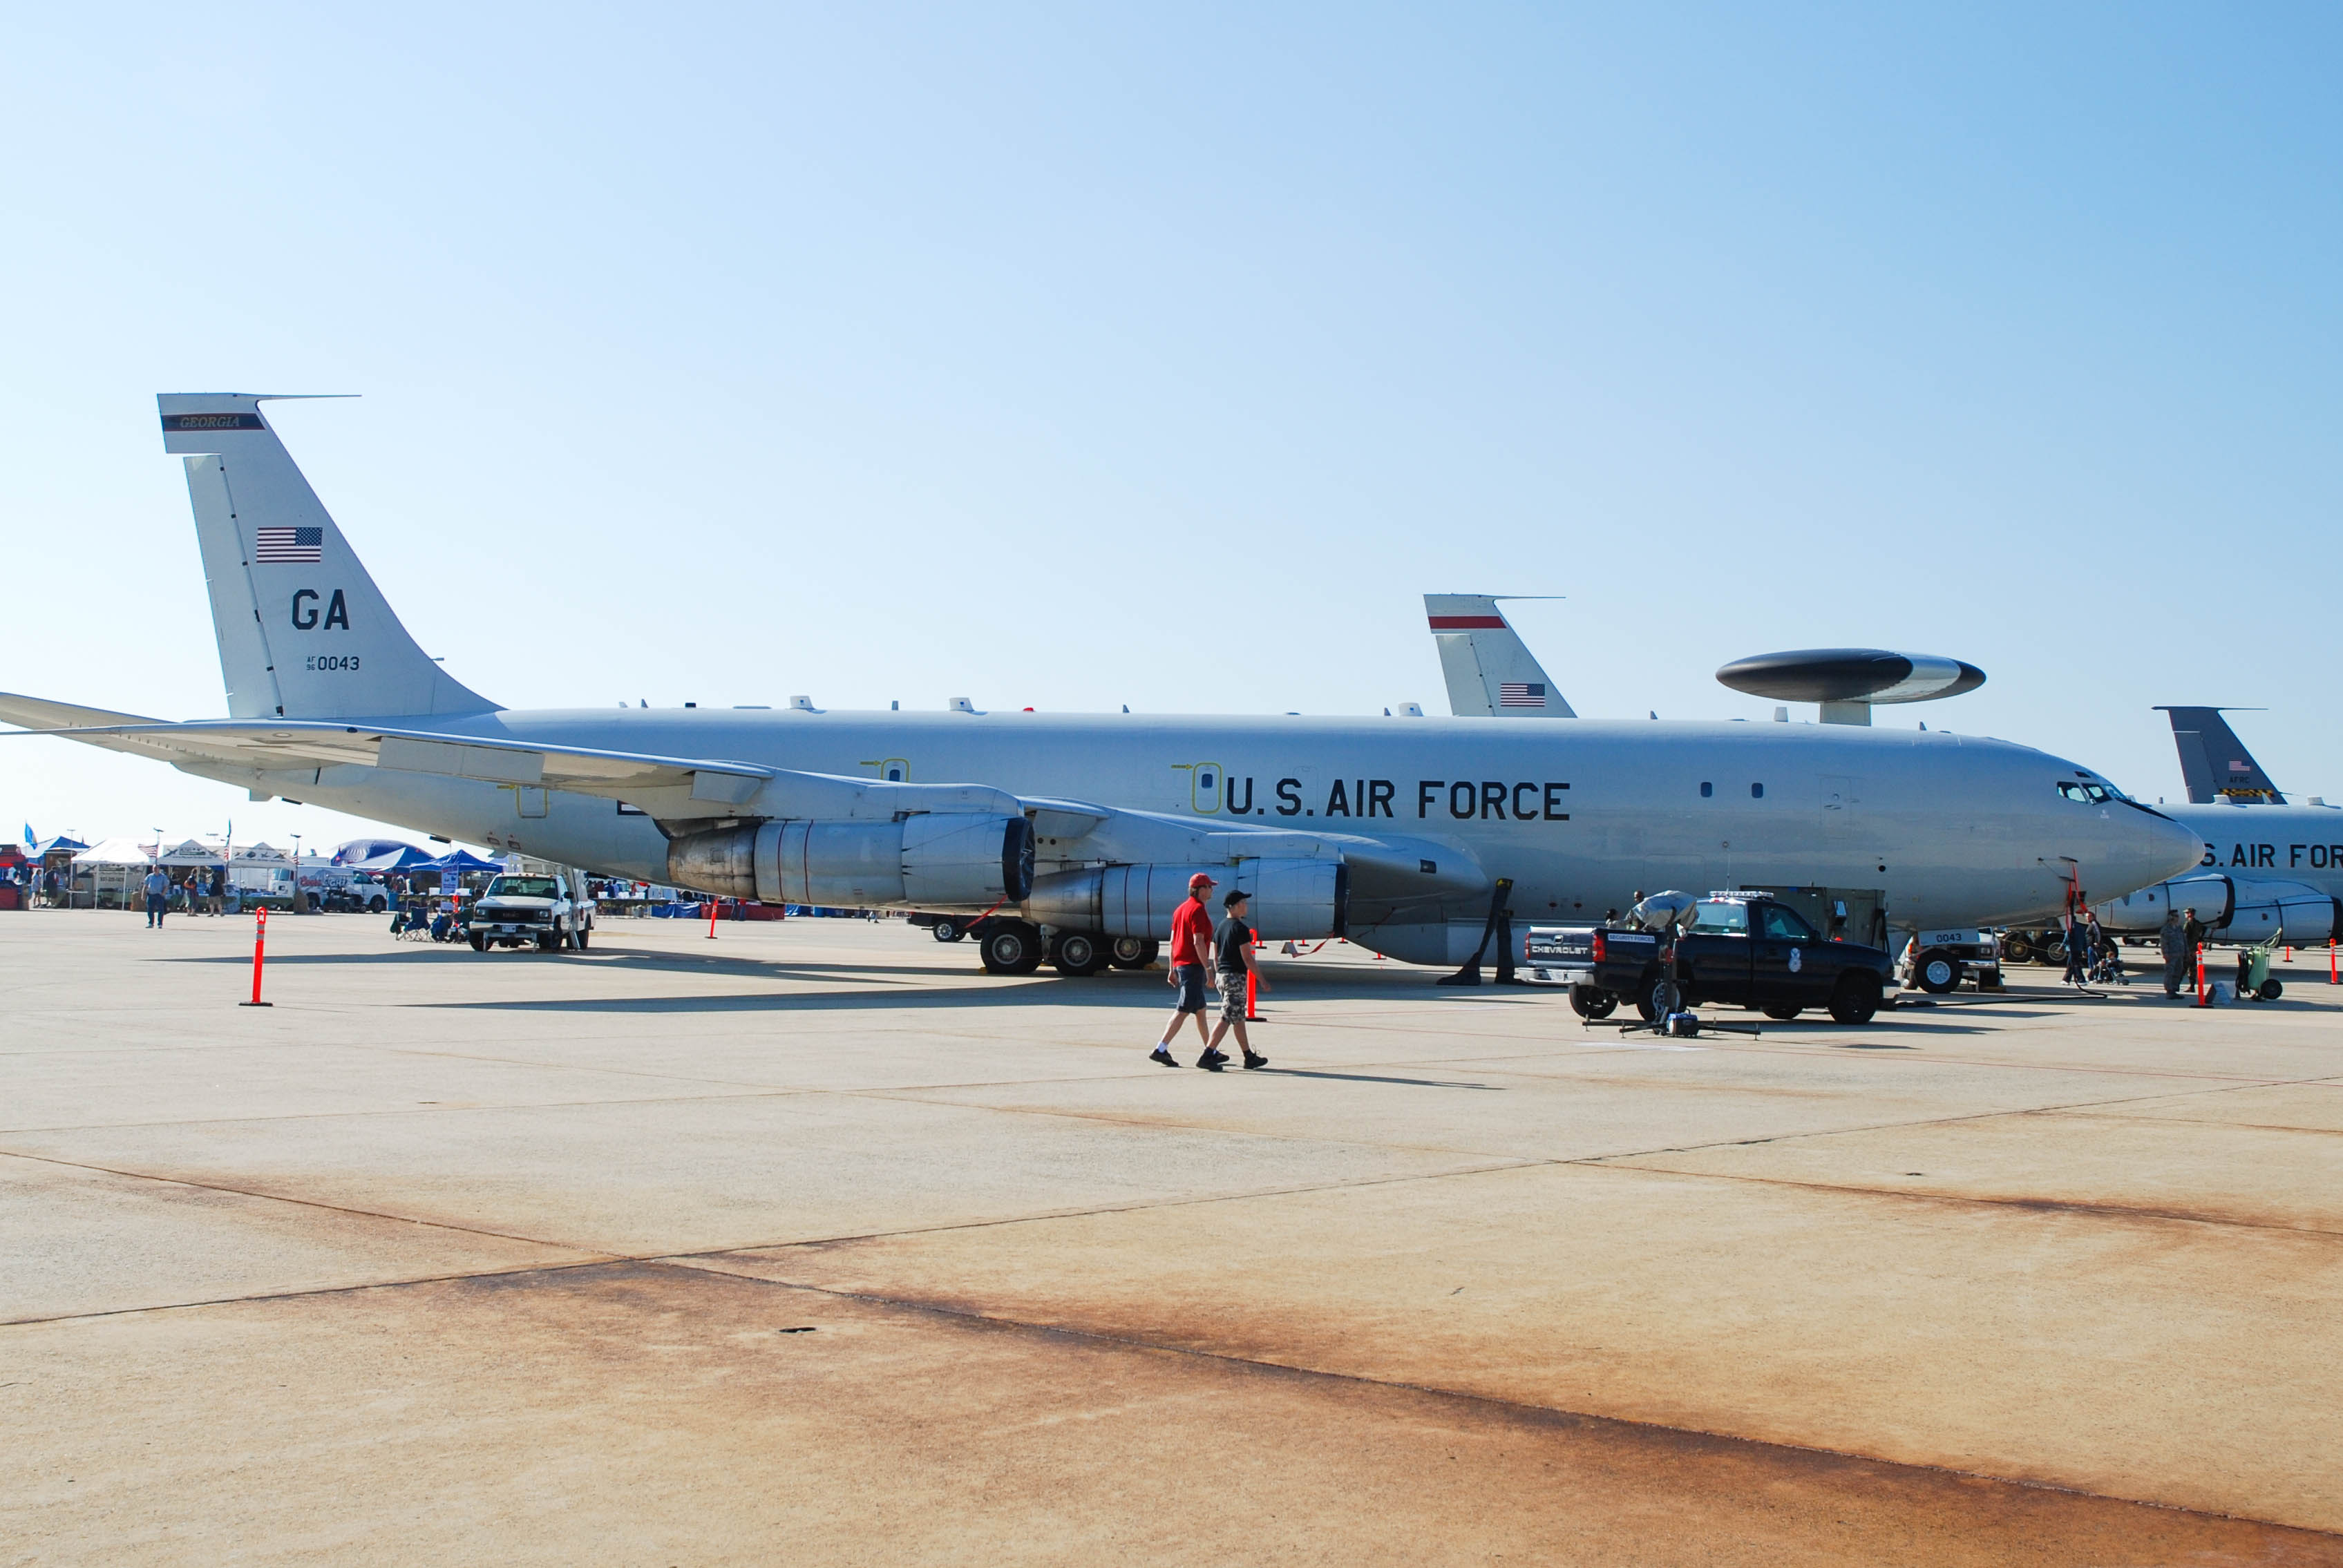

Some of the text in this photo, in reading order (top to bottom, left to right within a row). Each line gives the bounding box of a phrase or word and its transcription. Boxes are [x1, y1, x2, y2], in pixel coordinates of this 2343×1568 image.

[180, 417, 240, 428] GEORGIA
[292, 589, 350, 630] GA
[318, 656, 359, 671] 0043
[1326, 779, 1395, 818] AIR
[1419, 781, 1571, 821] FORCE
[2231, 843, 2275, 868] AIR
[1936, 933, 1962, 943] 0043
[1532, 946, 1588, 955] CHEVROLET
